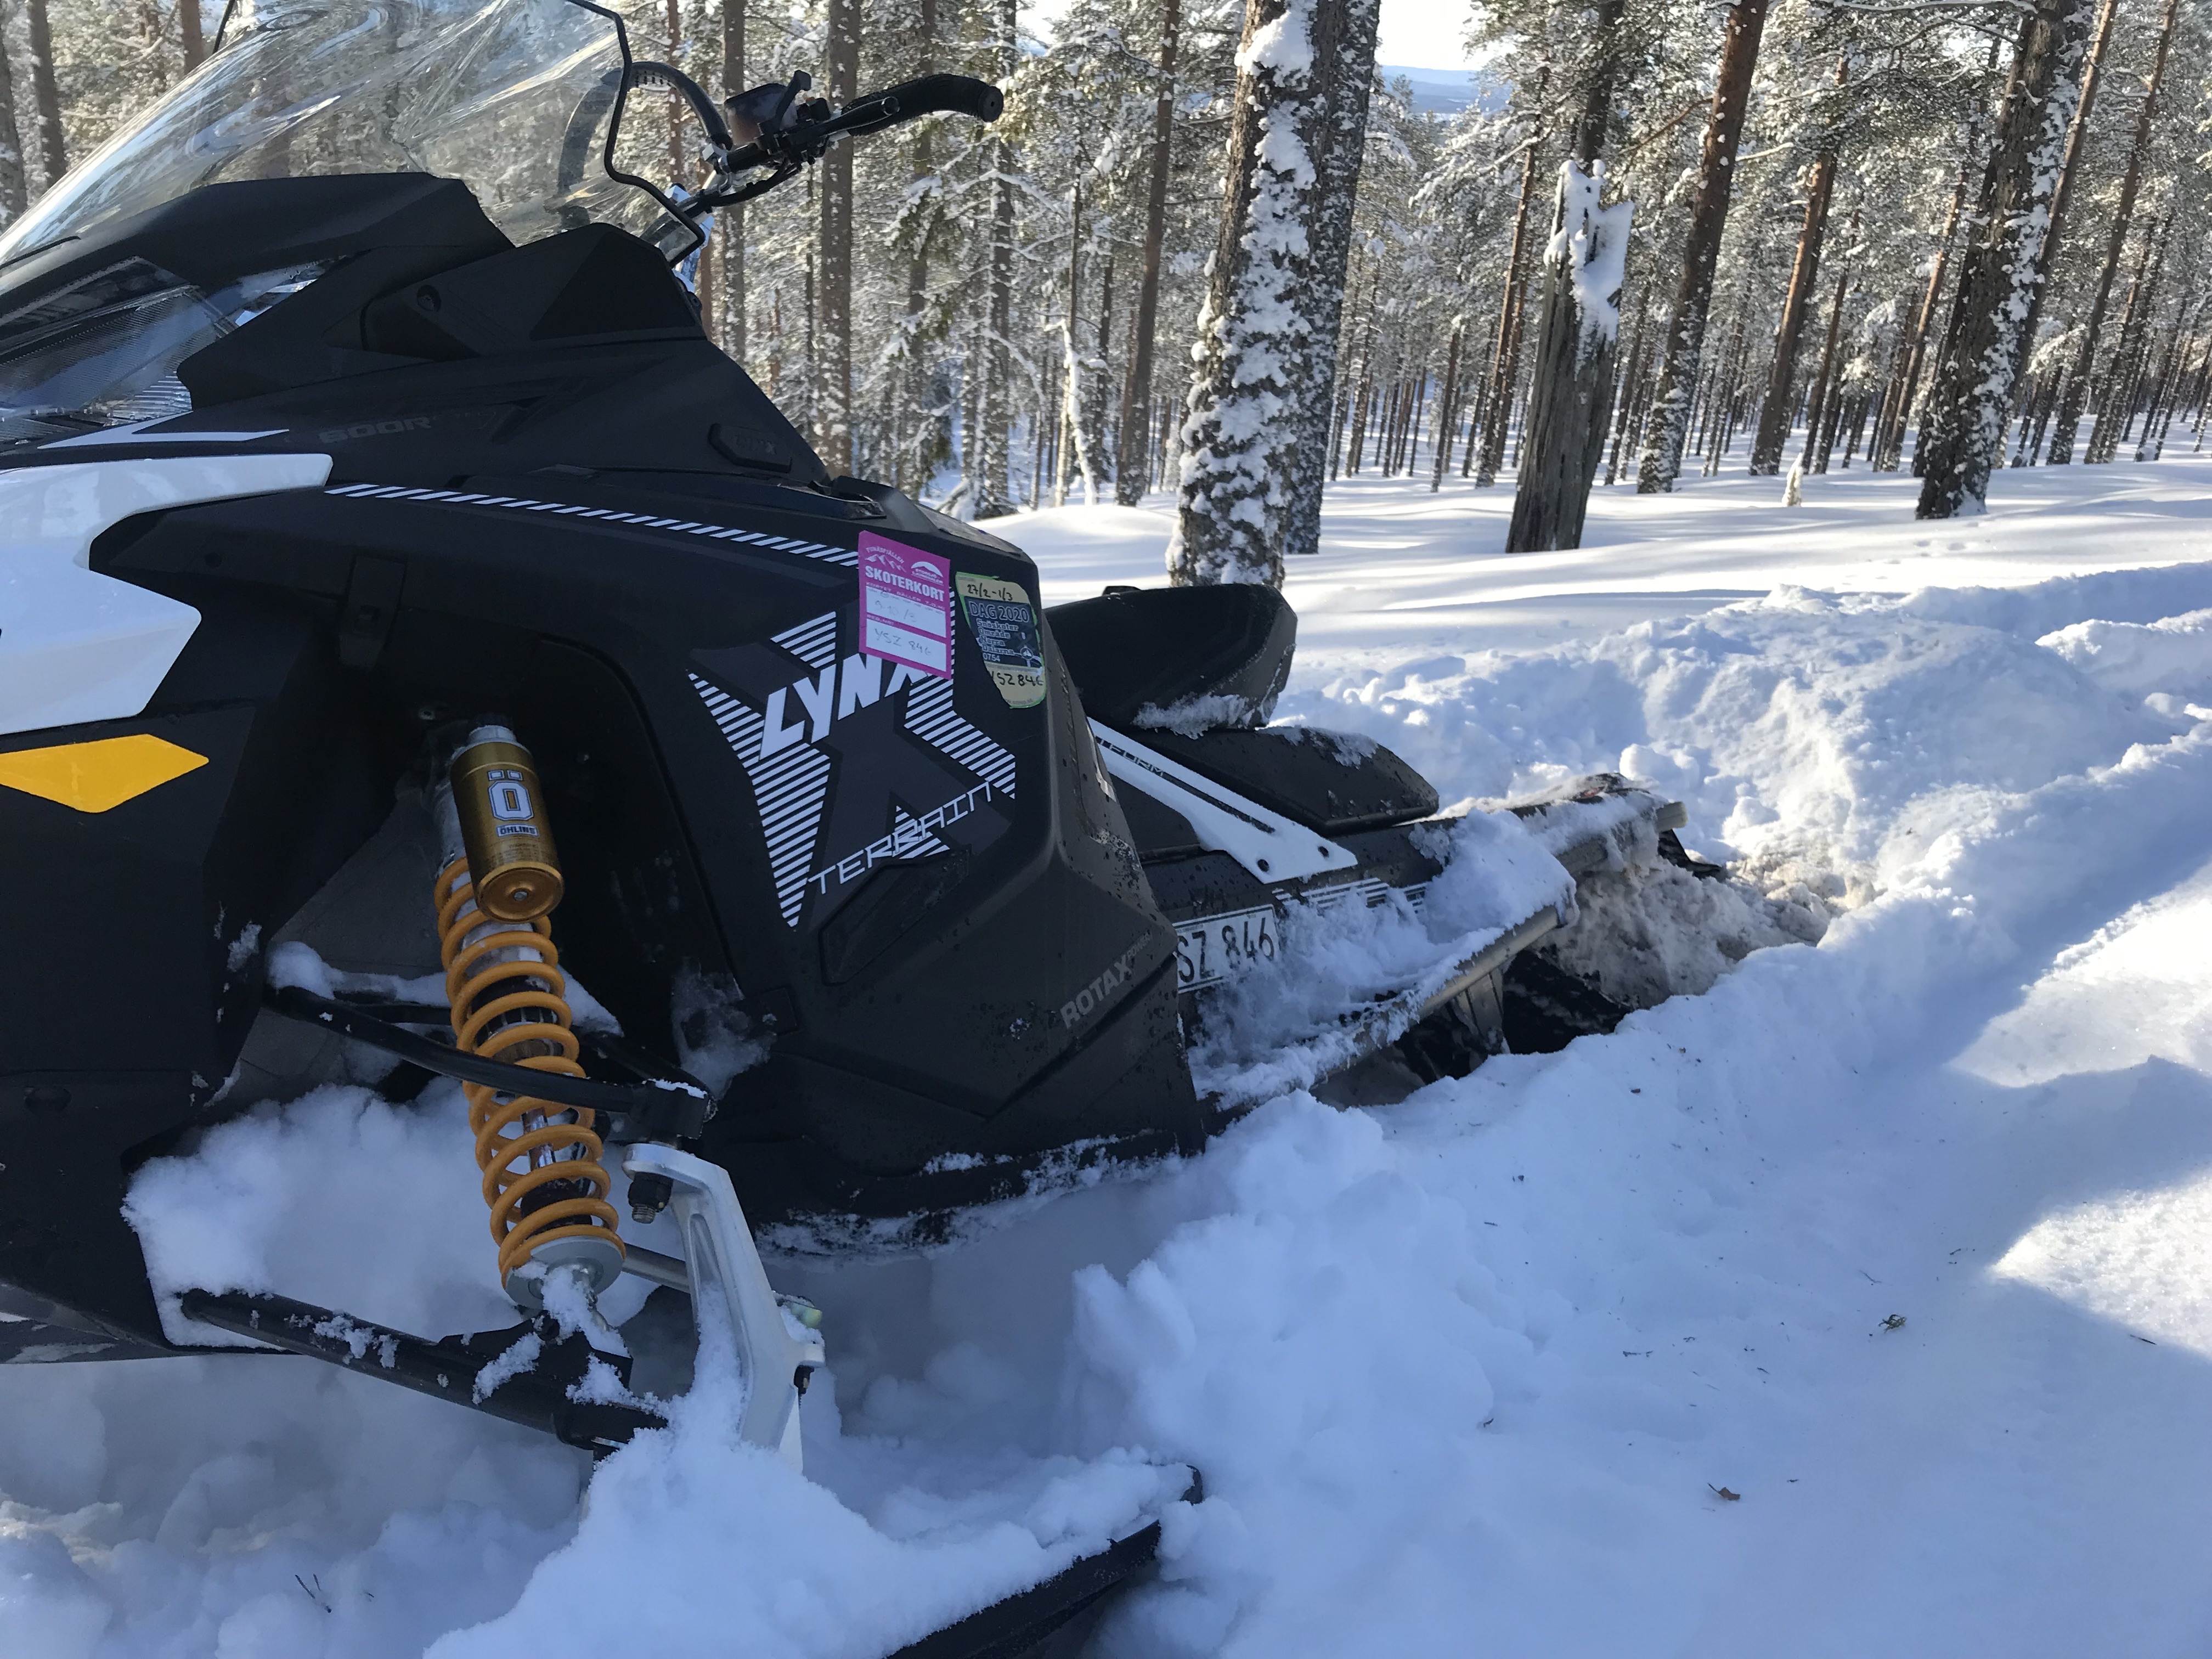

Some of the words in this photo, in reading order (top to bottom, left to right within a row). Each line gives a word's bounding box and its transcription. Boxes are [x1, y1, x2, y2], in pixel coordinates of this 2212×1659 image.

[319, 416, 432, 443] 600R
[865, 566, 945, 602] SKOTERKORT
[968, 601, 997, 619] DAG
[997, 606, 1029, 623] 2020
[976, 618, 1019, 631] Snöskoter
[978, 627, 1011, 639] Område
[979, 635, 1006, 647] Norra
[981, 644, 1015, 656] Dalarna
[983, 653, 1001, 662] 0754
[500, 826, 536, 834] ÖHLINS
[808, 781, 991, 895] TERRAIN
[1222, 917, 1274, 970] 846
[1059, 954, 1132, 1029] ROTAX
